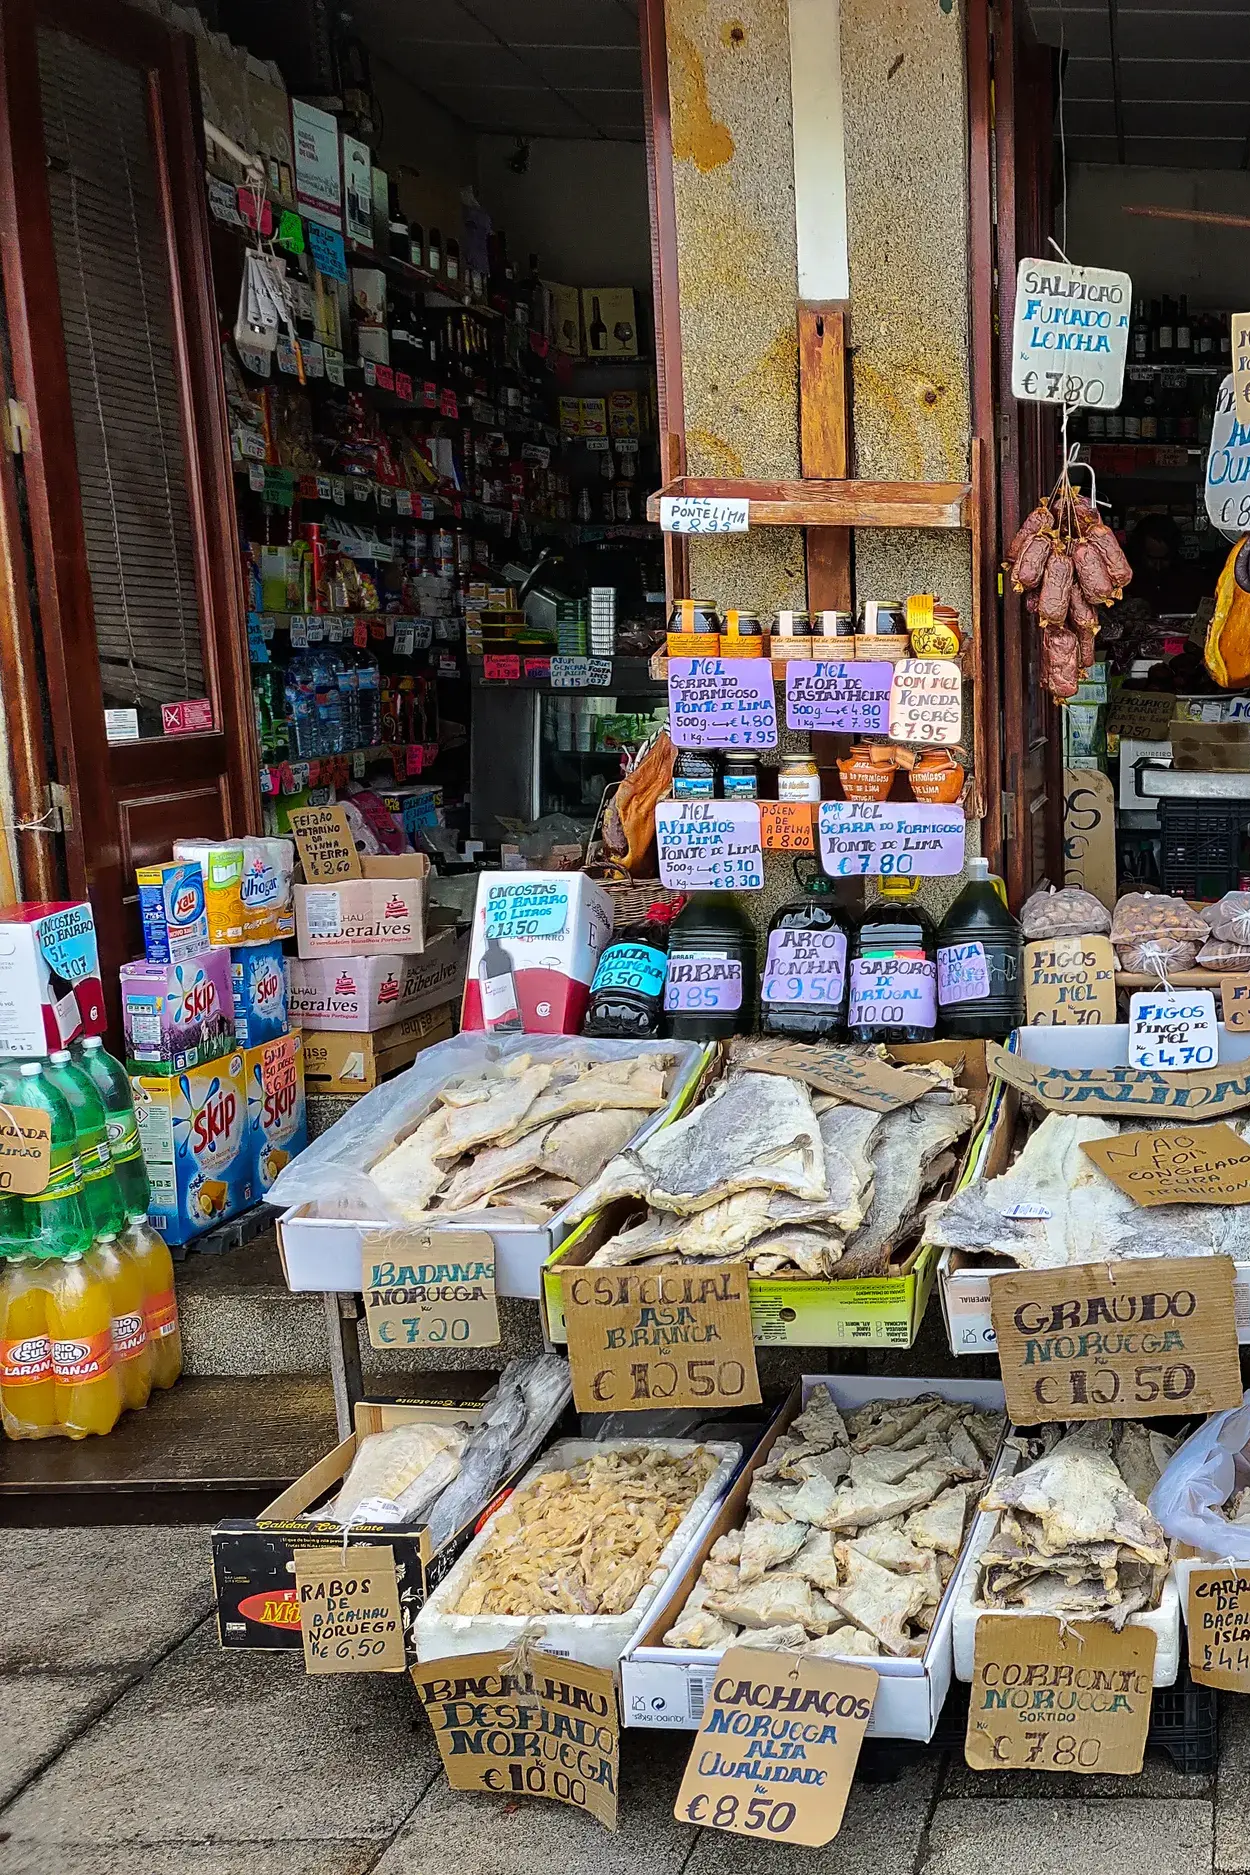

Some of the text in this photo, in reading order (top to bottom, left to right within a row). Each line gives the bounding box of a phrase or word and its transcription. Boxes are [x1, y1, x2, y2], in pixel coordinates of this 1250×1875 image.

[1022, 299, 1128, 328] FUMADO A
[1030, 326, 1111, 353] LENHA
[688, 659, 726, 676] MEL
[813, 663, 848, 678] MEL
[902, 659, 941, 674] POTE
[670, 675, 738, 688] SERRA DO
[792, 677, 862, 689] FLOR DE
[894, 675, 959, 690] COM MEL
[680, 688, 758, 700] FORMIGOSO
[897, 691, 960, 706] PENEDA
[675, 701, 718, 713] PONTE
[738, 700, 773, 710] LIMA
[858, 773, 890, 783] FORMIGOSO
[864, 784, 880, 793] LIMA
[679, 803, 716, 820] MEL
[850, 804, 883, 819] MEL
[776, 817, 789, 825] DE
[820, 821, 964, 834] SERRA DO FORMIGOSO
[766, 825, 810, 835] ABELHA
[306, 842, 339, 852] MINHA
[663, 834, 723, 845] DO LIMA
[781, 835, 809, 848] 8.00
[826, 837, 943, 854] PONTE DE LIMA
[309, 848, 349, 862] TERRA
[660, 844, 761, 860] PONTE DE LIMA
[858, 854, 912, 873] 7.80
[489, 884, 557, 899] ENCOSTAS
[487, 895, 568, 911] DO BAIRRO
[493, 908, 552, 922] 10 LITROS
[40, 911, 81, 936] ENCOSTAS
[44, 920, 94, 947] DO BAIRRO
[779, 931, 836, 948] ARCO
[792, 949, 820, 959] DA
[1031, 951, 1097, 969] FIGOS
[402, 961, 457, 998] Riberalves
[875, 977, 894, 986] DE
[1030, 970, 1112, 986] PINGO DE
[1136, 1004, 1205, 1021] FIGOS
[1134, 1022, 1189, 1034] PINGO
[1155, 1033, 1188, 1044] MEL
[1159, 1174, 1221, 1186] CURA
[368, 1262, 495, 1290] BADANAS
[572, 1272, 741, 1306] ESPECIAL
[369, 1286, 488, 1308] NORUEGA
[635, 1306, 697, 1328] ASA
[22, 1339, 45, 1351] RIO
[604, 1324, 722, 1351] BRANCA
[22, 1348, 46, 1360] SUL
[54, 1343, 75, 1352] RIO
[1019, 1329, 1187, 1367] NORUEGA
[54, 1350, 75, 1361] SUL
[256, 1520, 310, 1530] Calidad
[301, 1579, 371, 1603] RABOS
[327, 1598, 349, 1611] DE
[1217, 1596, 1239, 1611] DE
[313, 1607, 389, 1628] BACALHAU
[308, 1621, 396, 1642] NORUEGA
[712, 1678, 871, 1720] CACHAÇOS
[979, 1688, 1135, 1715] NORUEGA
[1018, 1710, 1076, 1724] SORTIDO
[703, 1708, 838, 1745] NORUEGA
[743, 1740, 807, 1760] ALTA
[449, 1728, 616, 1796] NORUEGA
[697, 1750, 828, 1787] QUALIDADE
